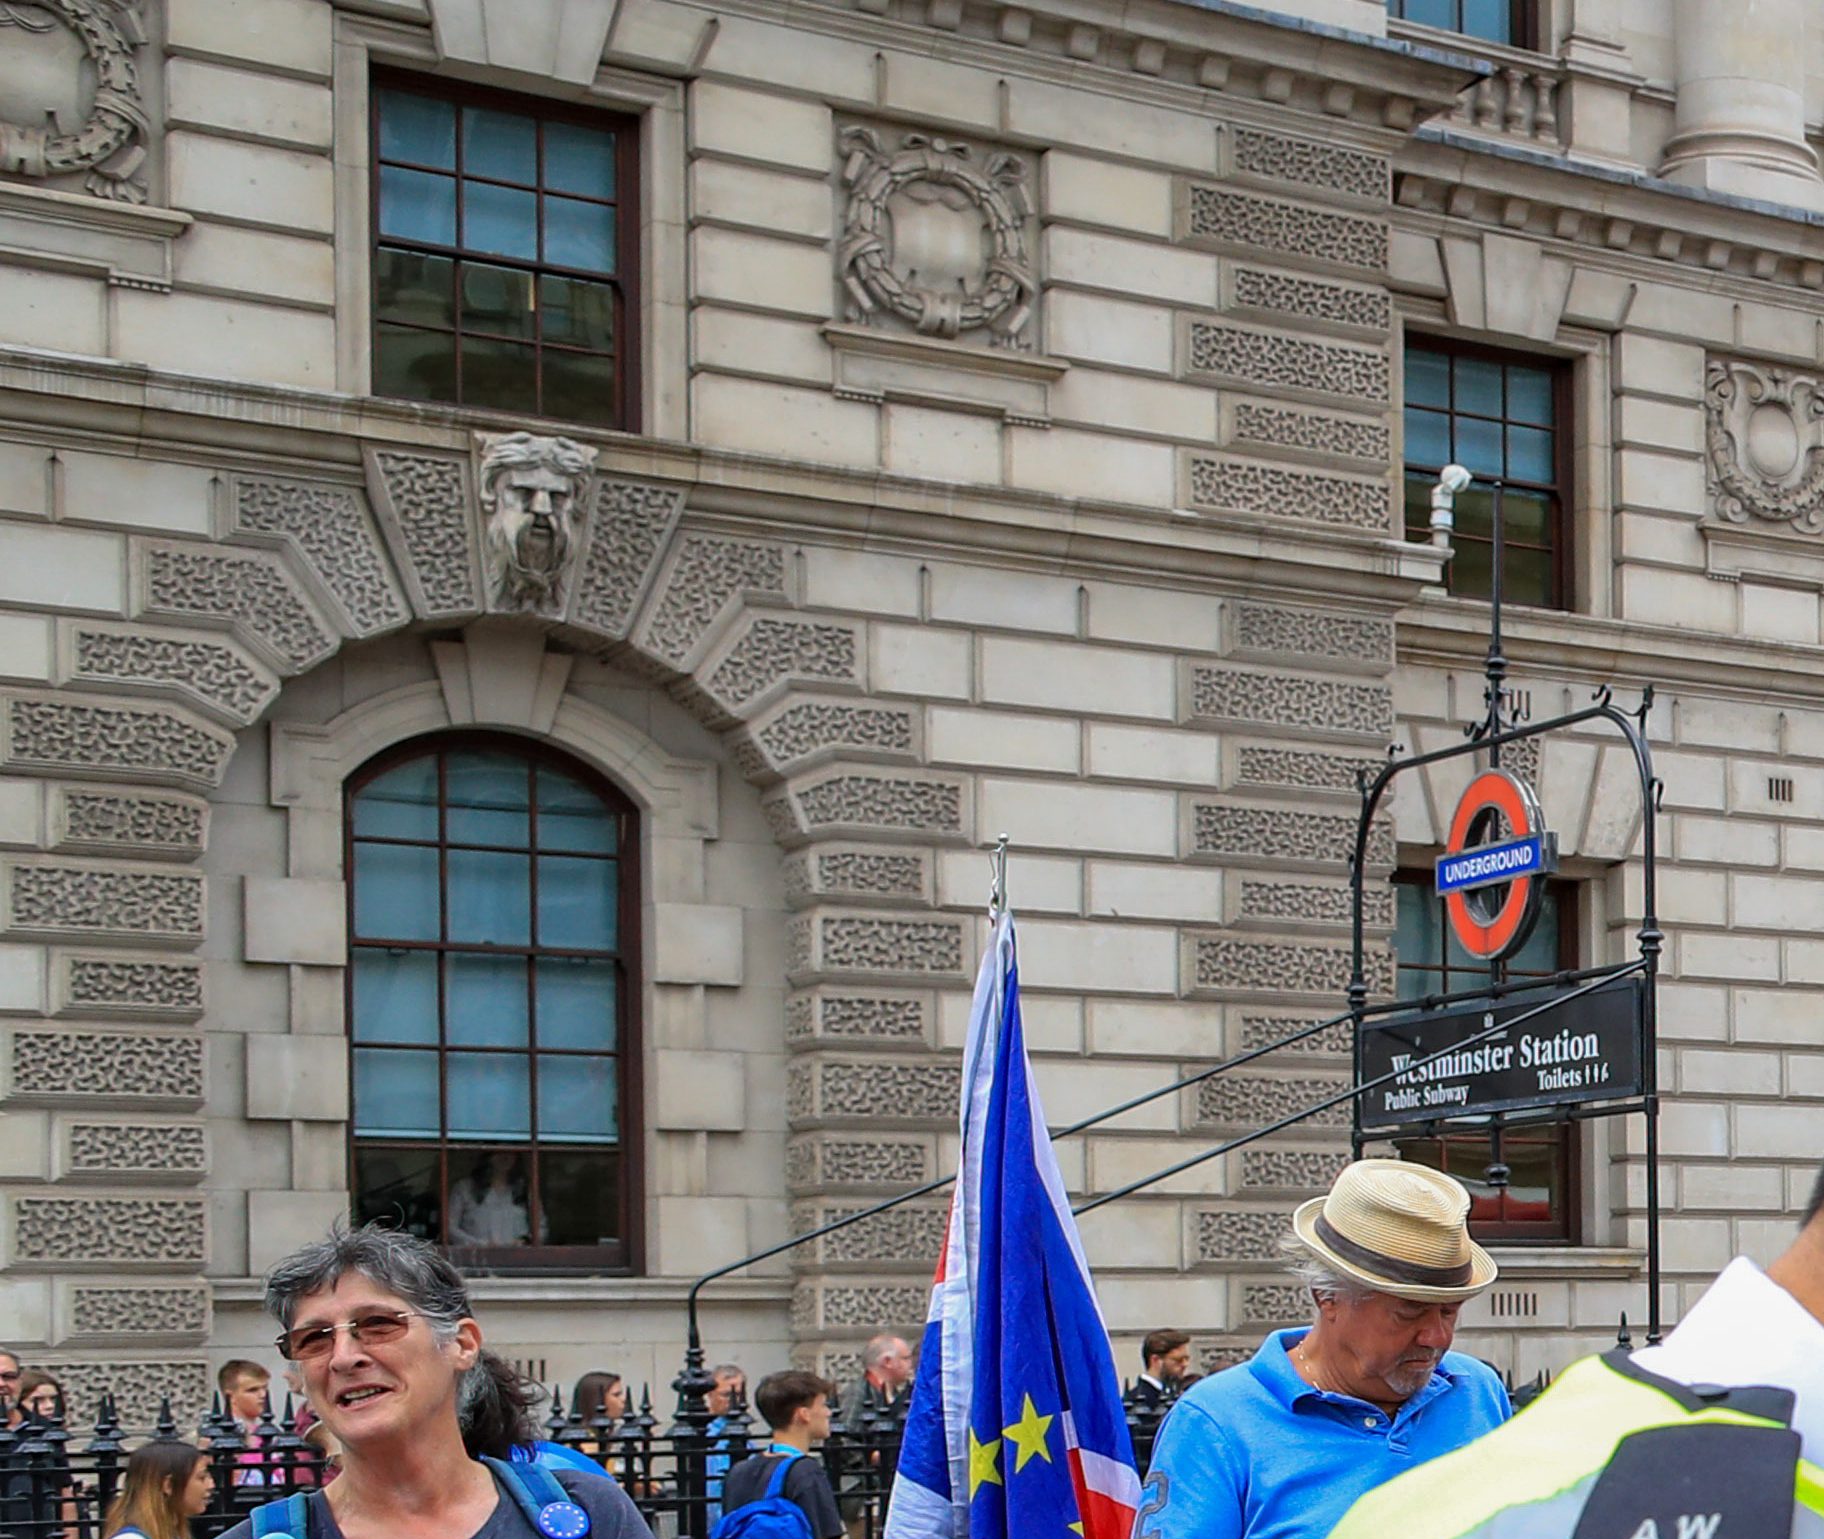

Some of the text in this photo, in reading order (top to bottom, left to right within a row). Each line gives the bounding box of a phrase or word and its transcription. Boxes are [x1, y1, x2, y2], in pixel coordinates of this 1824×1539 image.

[1445, 845, 1533, 884] UNDERGROUND
[1390, 1029, 1600, 1086] Westminster Station
[1537, 1067, 1583, 1091] Toilets
[1384, 1084, 1470, 1112] Public Subway
